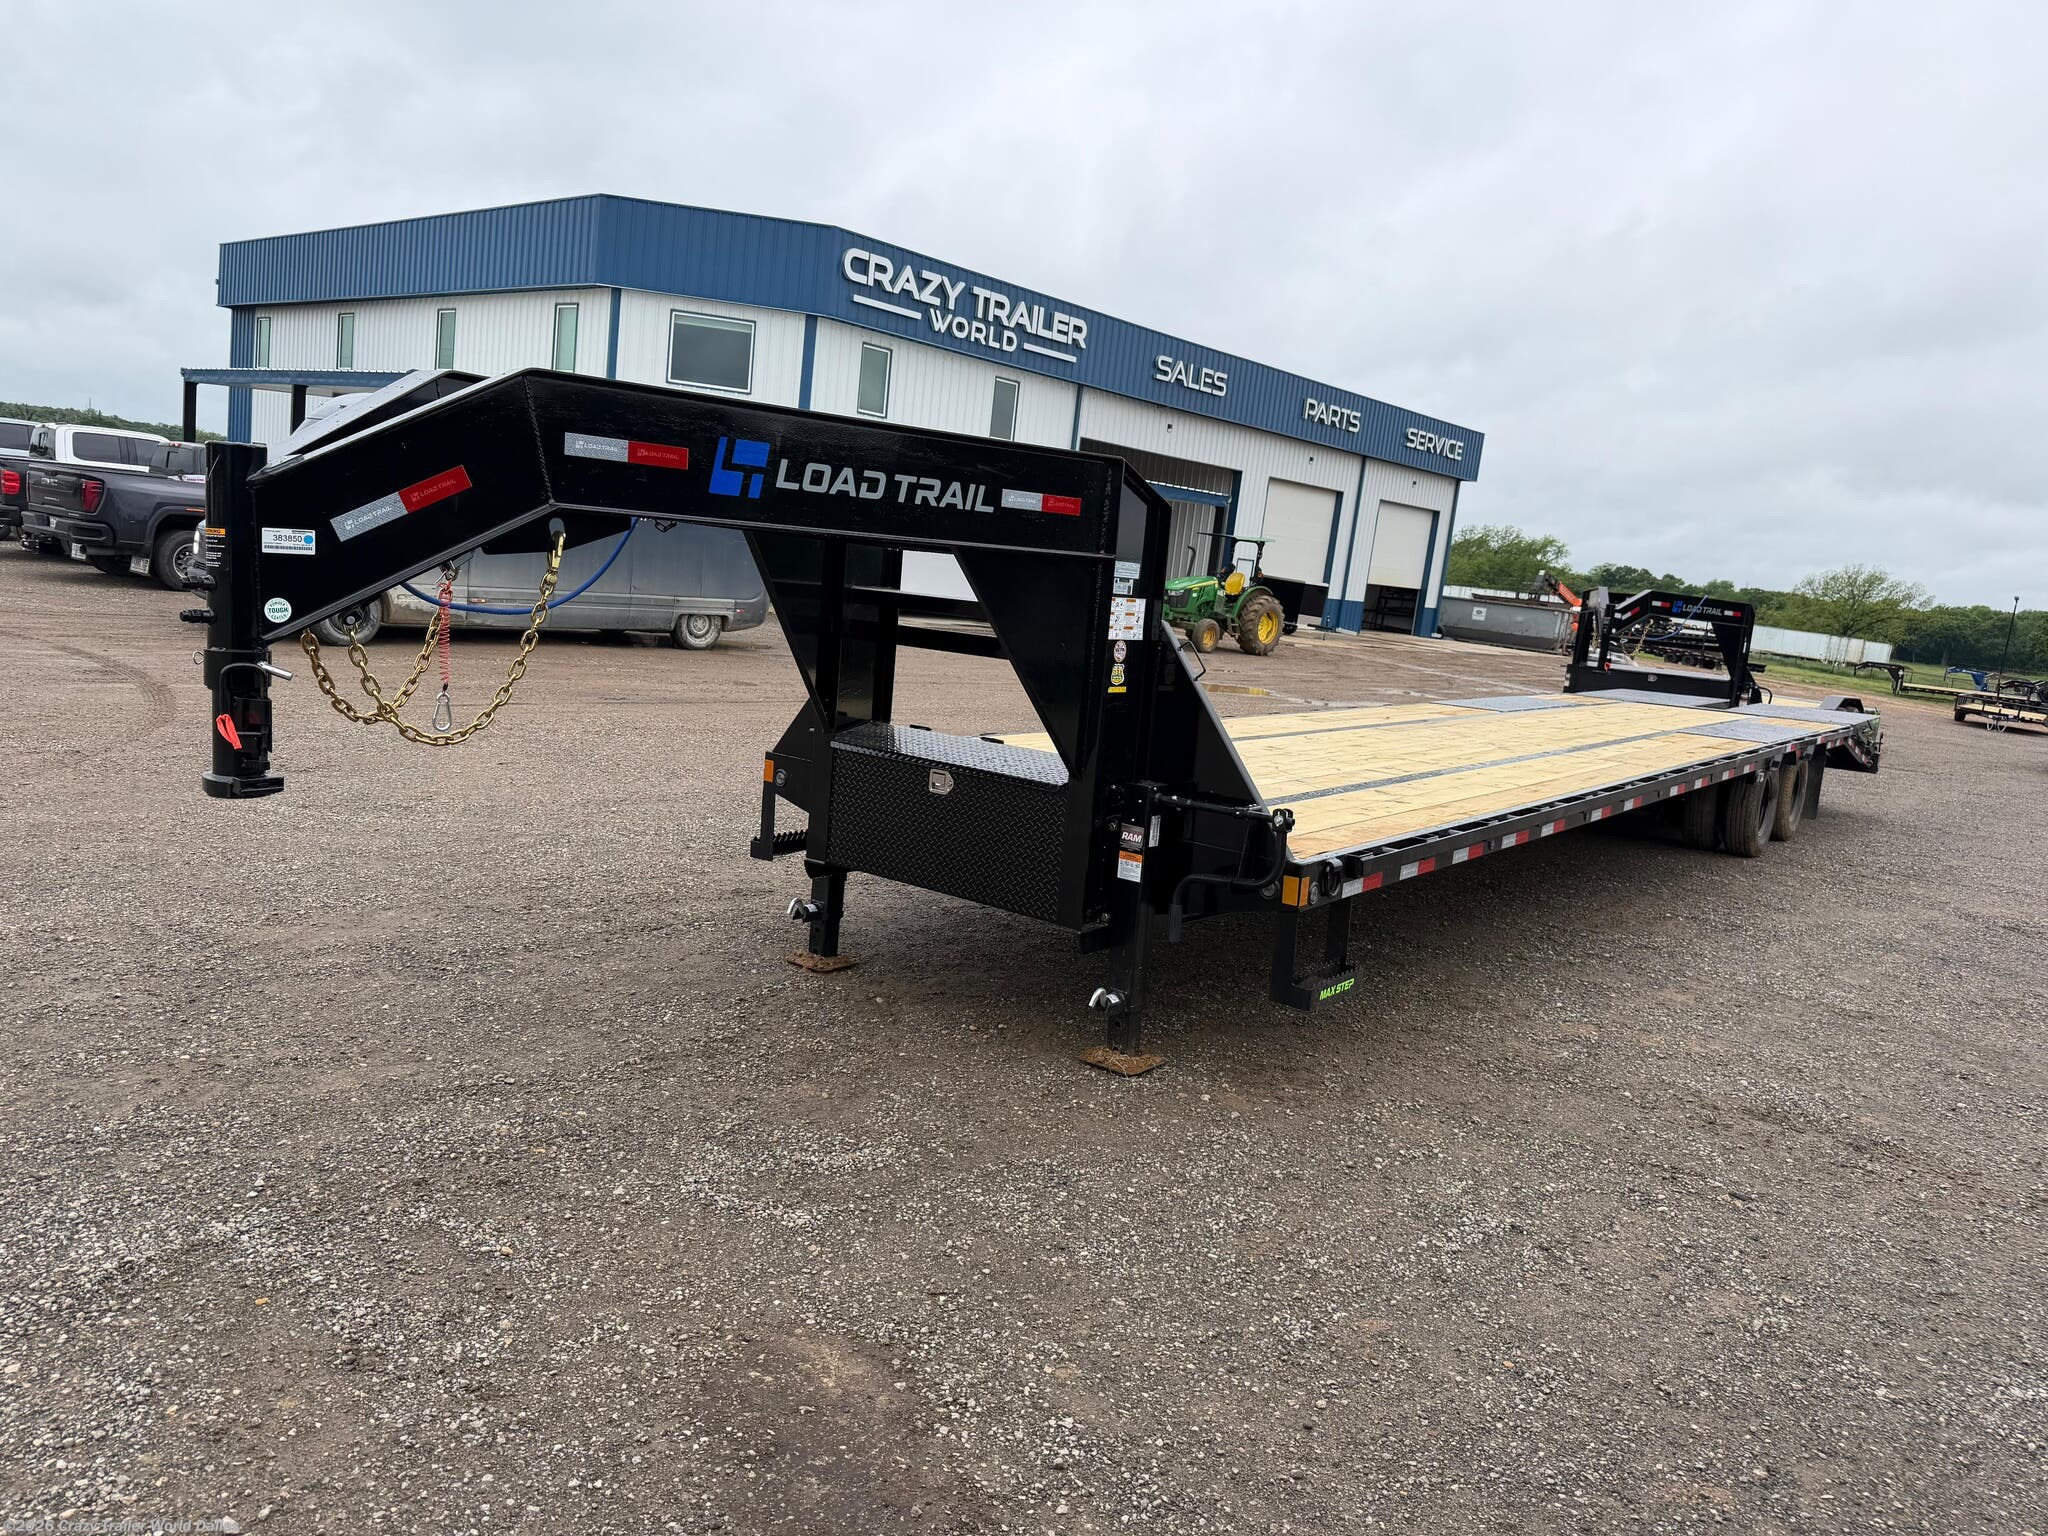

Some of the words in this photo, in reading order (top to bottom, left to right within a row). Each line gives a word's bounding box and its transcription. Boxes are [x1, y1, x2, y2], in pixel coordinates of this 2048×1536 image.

[842, 247, 966, 311] CRAZY
[970, 285, 1088, 349] TRAILER
[928, 307, 1018, 353] WORLD
[1153, 354, 1228, 397] SALES
[1302, 397, 1361, 433] PARTS
[1405, 427, 1464, 461] SERVICE
[419, 485, 438, 498] LOAD
[437, 479, 457, 490] TRAIL
[775, 458, 887, 500] LOAD
[894, 473, 994, 513] TRAIL
[354, 512, 373, 525] LOAD
[373, 505, 393, 517] TRAIL
[272, 534, 303, 542] 383850
[1702, 606, 1723, 616] TRAIL
[1121, 831, 1142, 843] RAM
[1319, 985, 1337, 1000] MAX
[1336, 978, 1355, 993] STEP
